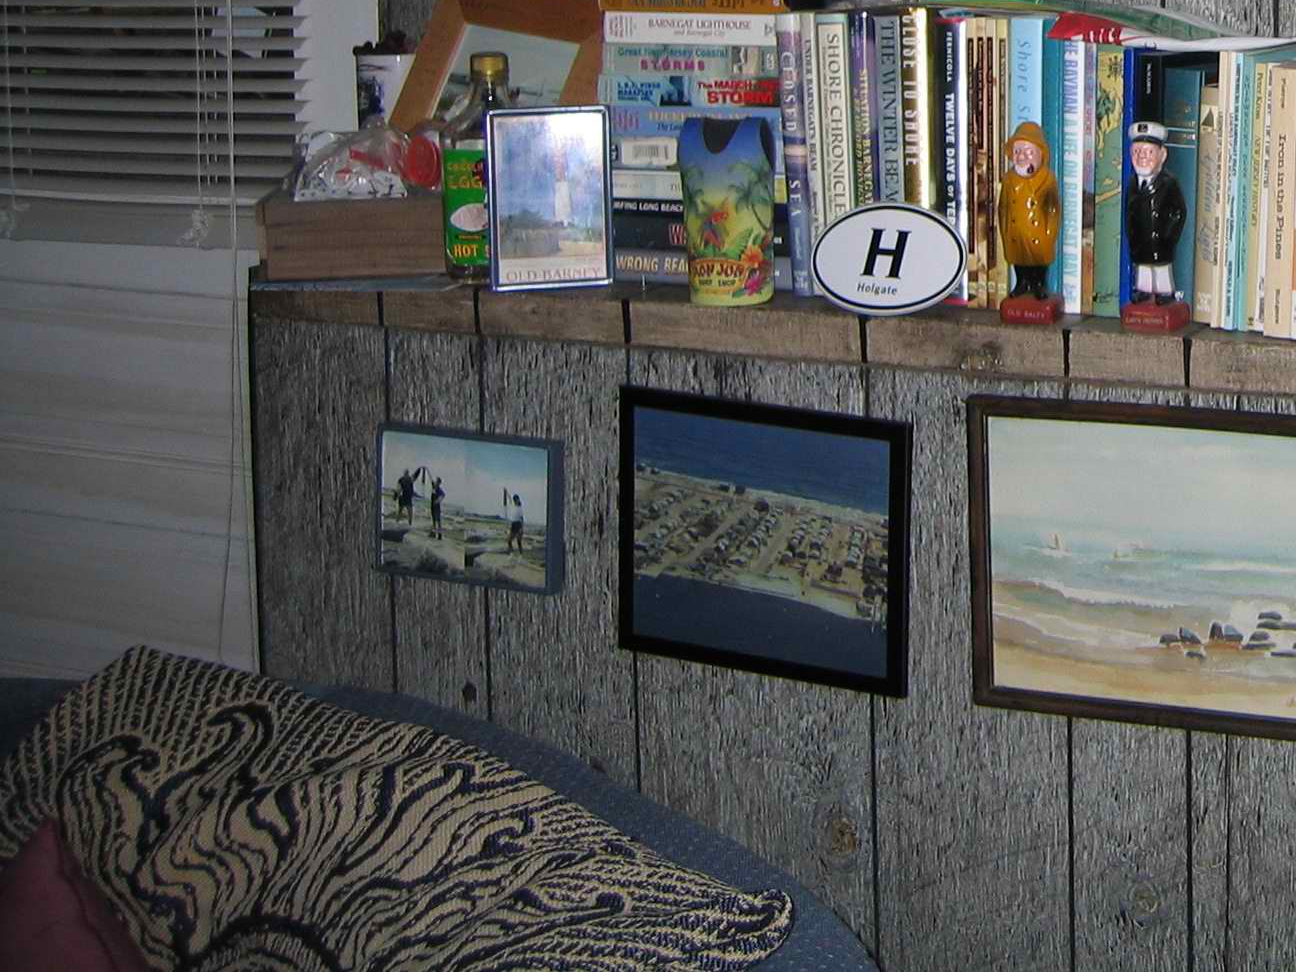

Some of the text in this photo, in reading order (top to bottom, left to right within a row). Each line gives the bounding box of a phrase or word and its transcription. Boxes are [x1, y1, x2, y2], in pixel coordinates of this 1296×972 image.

[648, 20, 751, 30] BARNEGAT LIGHTHOUSE
[640, 58, 705, 72] STORMS
[826, 33, 843, 101] SHORE
[1016, 40, 1034, 93] Shore
[1254, 72, 1264, 95] Peter
[707, 91, 774, 105] STORM
[781, 51, 798, 132] CLOSED
[880, 20, 899, 152] THE WINTER
[902, 14, 921, 166] CLOSE TO SHORE
[1063, 59, 1079, 114] BAYMAN
[944, 31, 957, 181] FERNICOLA TWELVE DAYS
[1063, 118, 1078, 127] A
[808, 142, 819, 172] BEAM
[861, 138, 874, 205] BARNEGAT
[788, 180, 803, 217] SEA
[1199, 154, 1217, 212] Golden
[1273, 134, 1287, 260] Iron in the Pines
[638, 202, 660, 212] LONG
[453, 244, 479, 258] HOT
[615, 254, 659, 272] WRONG
[858, 227, 913, 280] H
[505, 266, 600, 282] OLD BARNEY
[856, 282, 898, 297] Holgate
